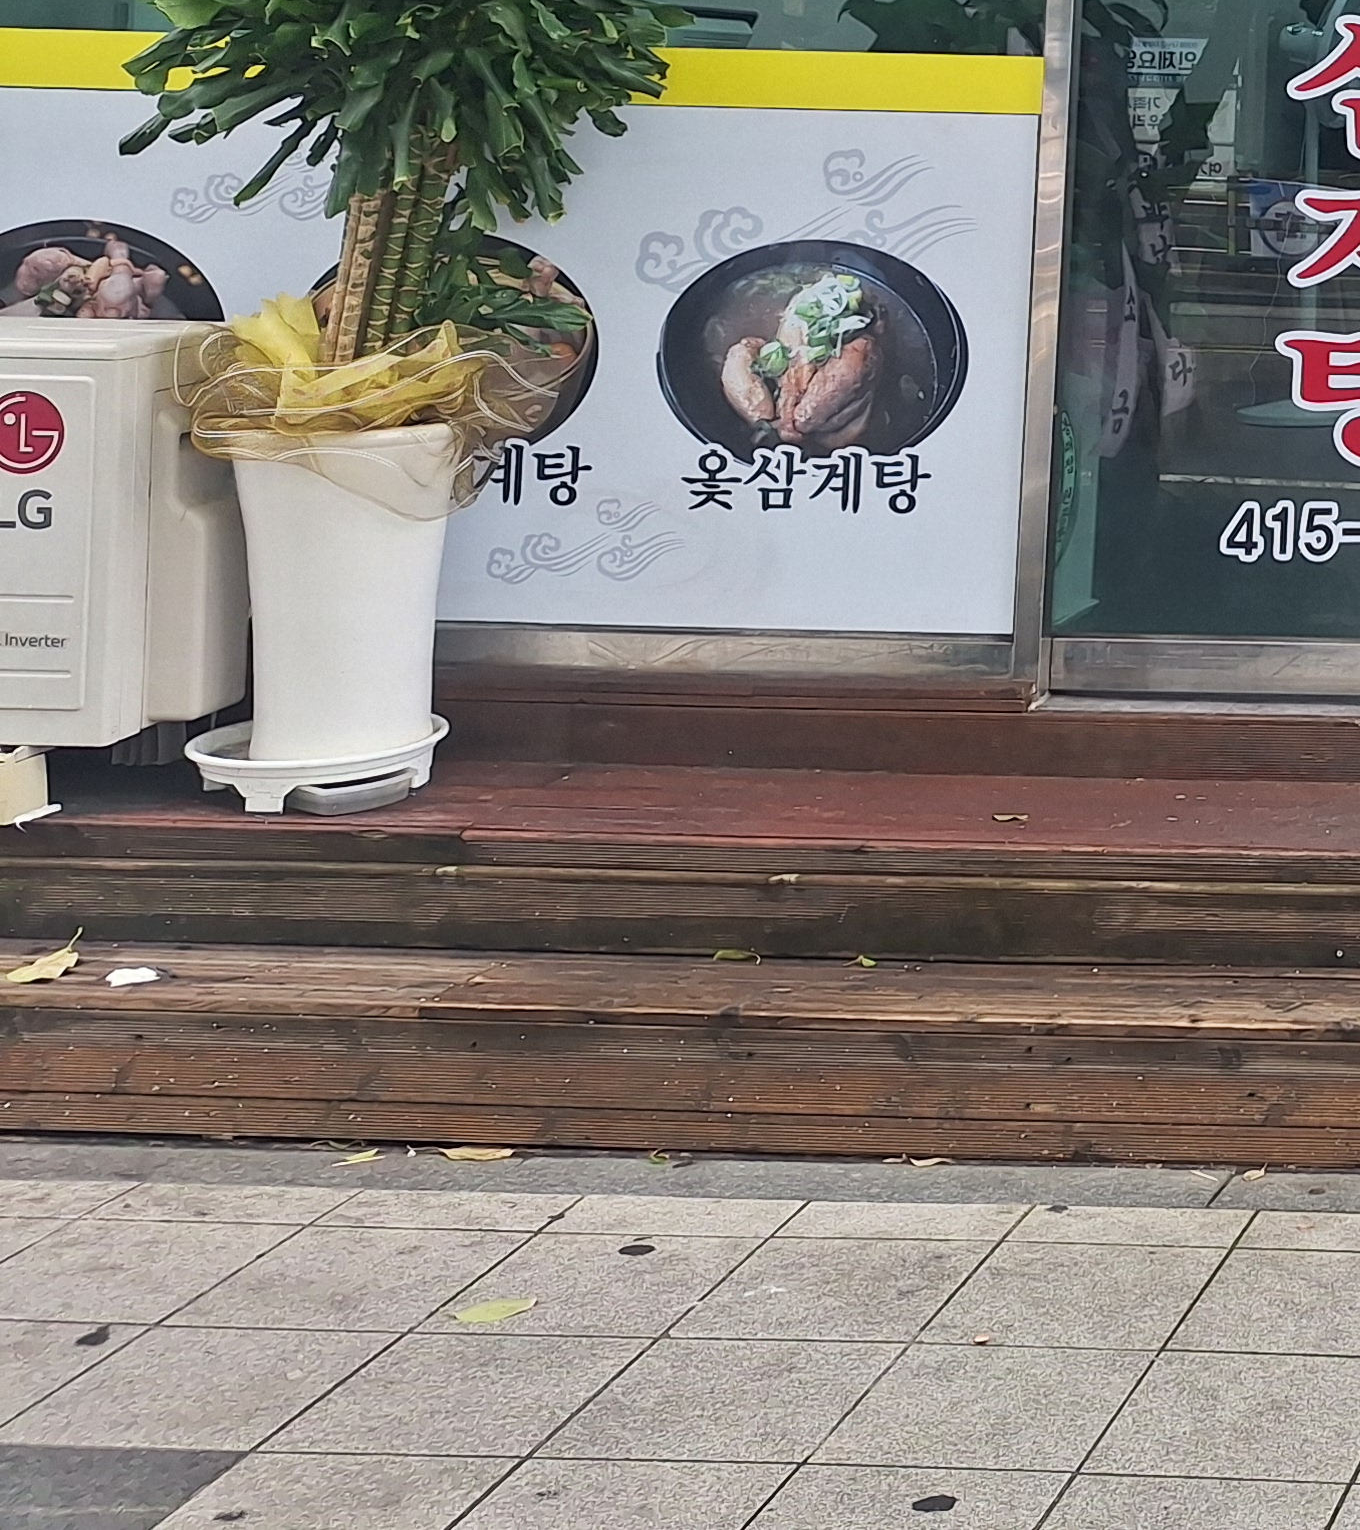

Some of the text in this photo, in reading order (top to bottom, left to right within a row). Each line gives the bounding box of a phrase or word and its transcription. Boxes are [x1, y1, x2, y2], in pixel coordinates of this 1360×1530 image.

[471, 443, 932, 514] 계탕 옻삼계탕
[4, 635, 67, 650] Inverter
